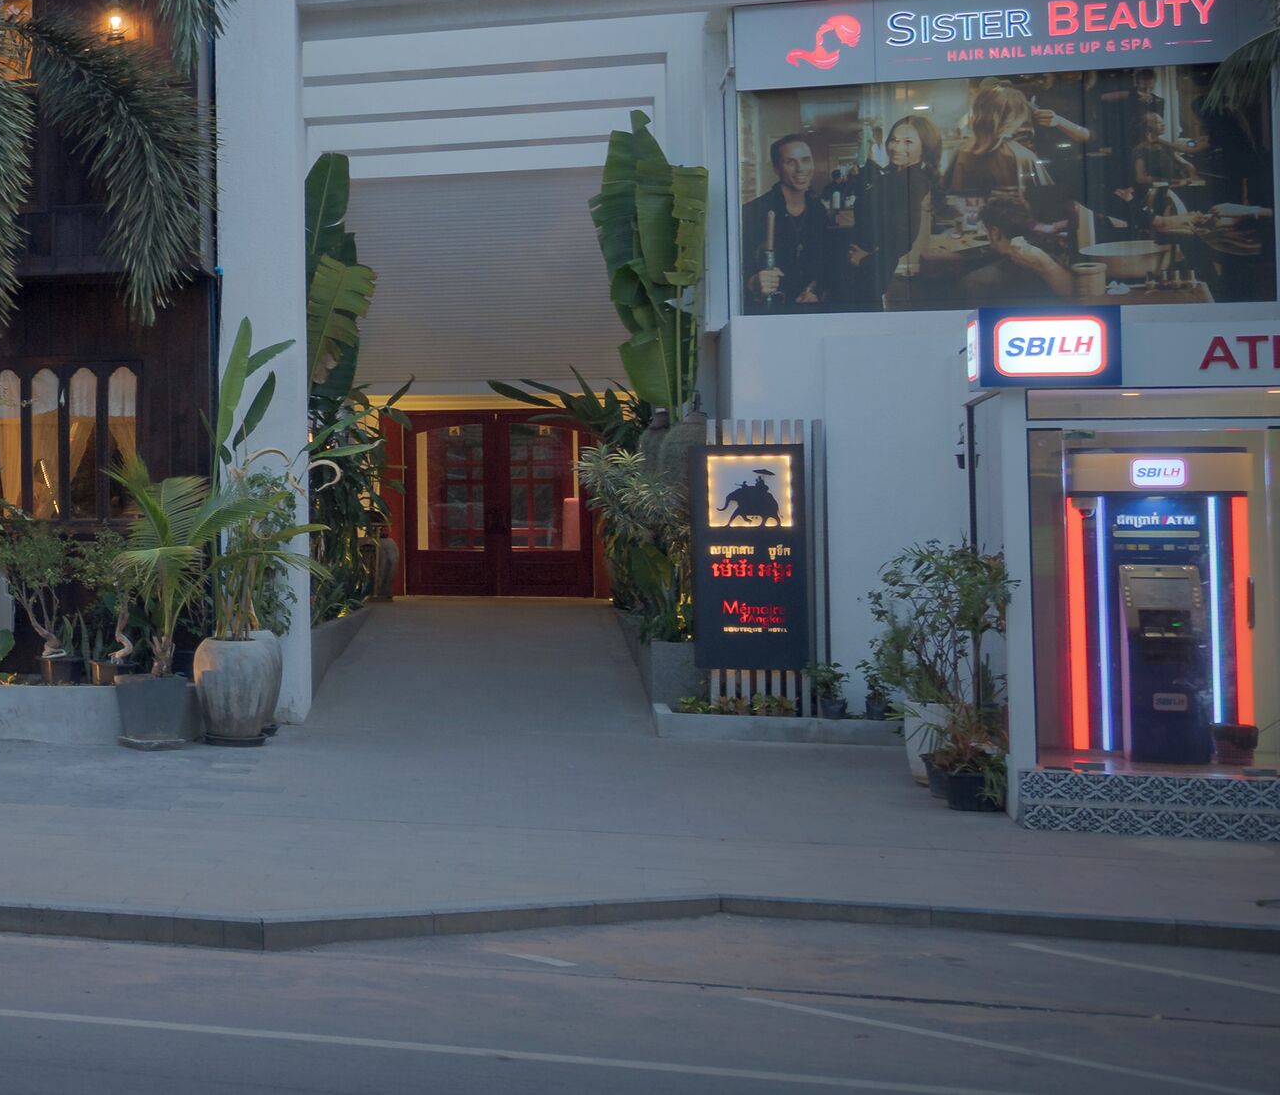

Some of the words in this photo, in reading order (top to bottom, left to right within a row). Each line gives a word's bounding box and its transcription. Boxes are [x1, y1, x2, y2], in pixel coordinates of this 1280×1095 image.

[886, 9, 1032, 47] SISTER
[947, 48, 984, 62] HAIR
[989, 46, 1025, 59] NAIL
[1031, 43, 1074, 56] MAKE
[1079, 41, 1101, 54] UP
[1105, 39, 1116, 52] &
[1120, 38, 1152, 51] SPA
[1005, 337, 1055, 356] SBI
[1057, 335, 1094, 354] LH
[1199, 335, 1280, 370] AT
[1137, 467, 1161, 478] SBI
[1163, 467, 1180, 477] LH
[723, 626, 763, 634] BOUTIQUE
